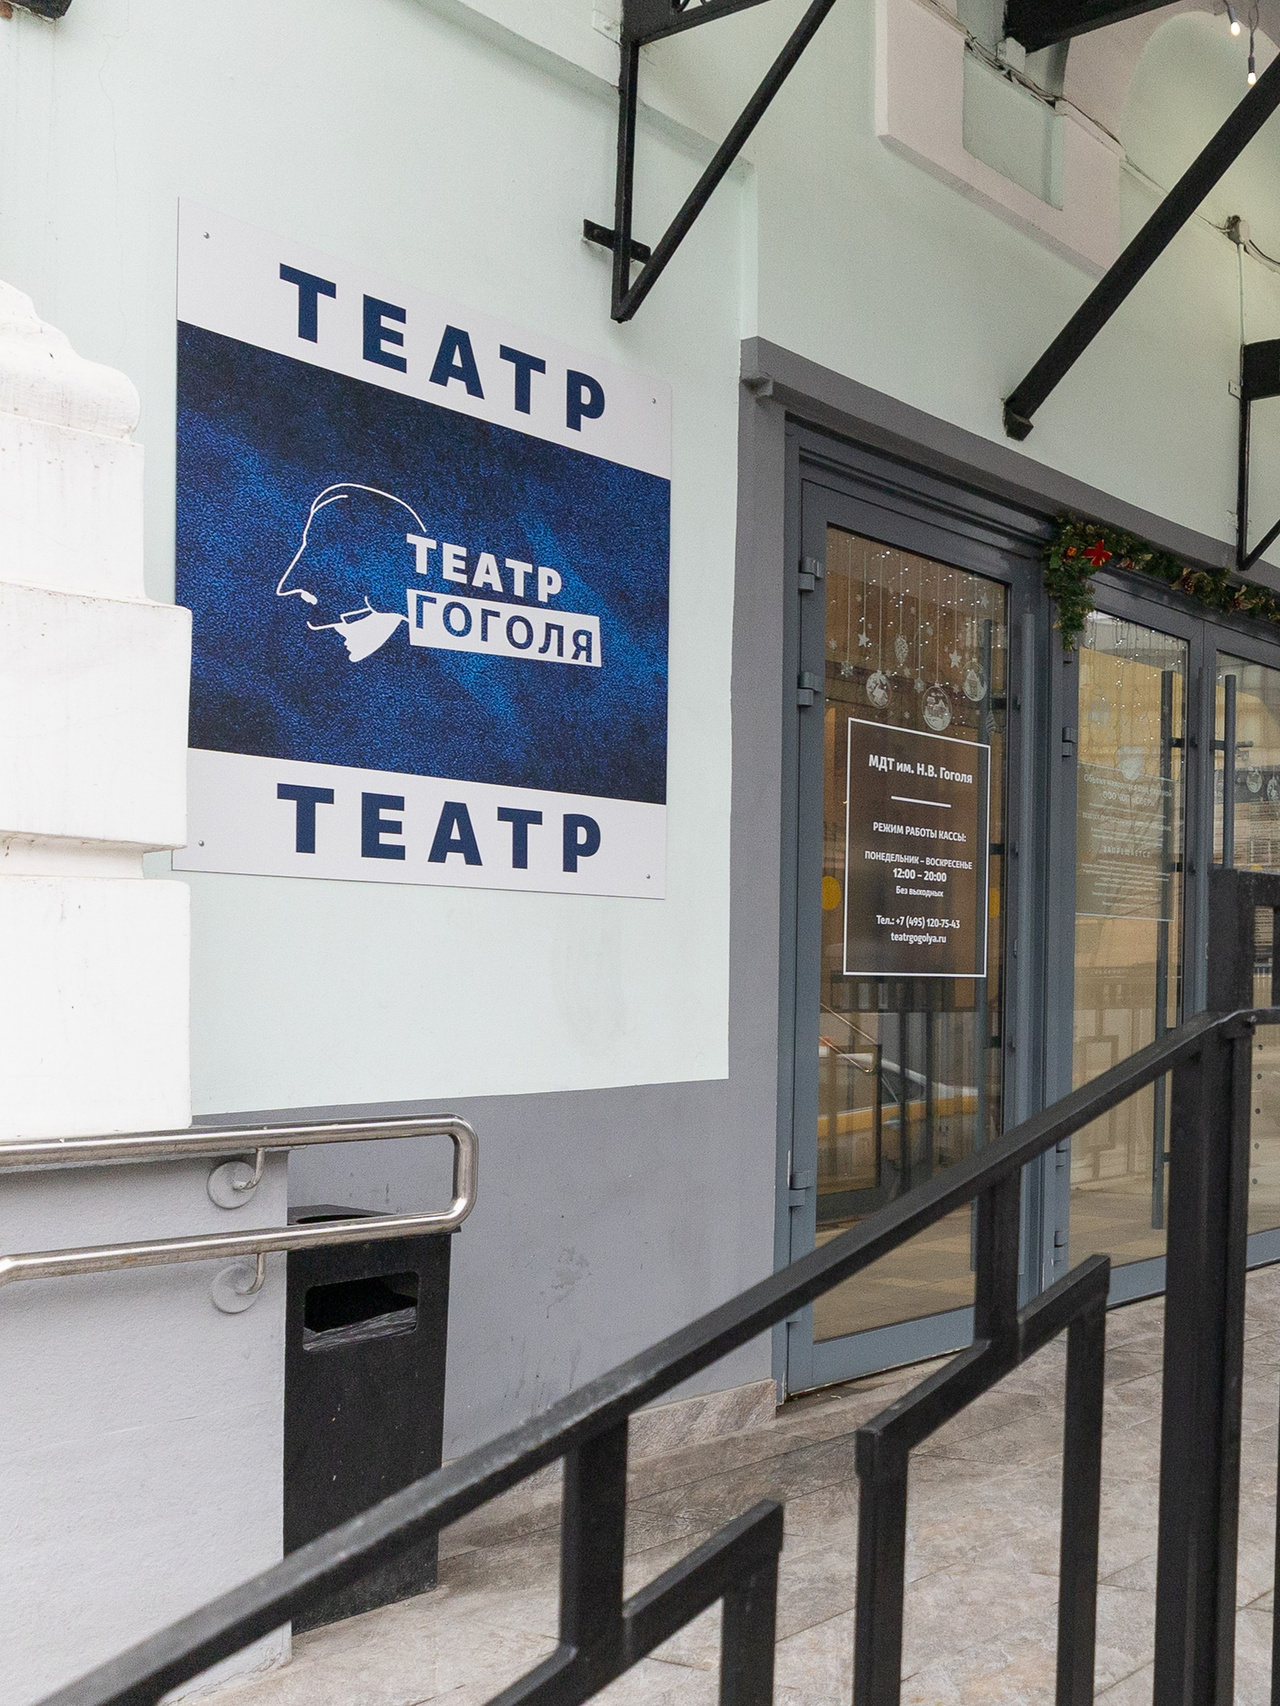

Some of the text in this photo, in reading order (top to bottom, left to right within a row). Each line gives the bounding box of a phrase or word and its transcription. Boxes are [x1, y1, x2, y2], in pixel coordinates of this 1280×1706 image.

[279, 262, 606, 432] ТЕАТР
[407, 533, 562, 603] ТЕАТР
[415, 596, 593, 664] ГОГОЛЯ
[868, 754, 973, 784] МДТ им. Н.В. Гоголя
[277, 782, 602, 873] ТЕАТР
[873, 821, 967, 842] РЕЖИМ РАБОТЫ КАССЫ:
[864, 850, 920, 864] ПОНЕДЕЛЬНИК
[925, 857, 973, 870] ВОСКРЕСЕНЬЕ
[893, 867, 916, 879] 12:00
[923, 870, 947, 882] 20:00
[895, 885, 944, 897] Без выходных
[876, 915, 960, 929] Тел.: +7 (495) 120-75-43
[890, 932, 947, 945] teatrgogolya.ru
